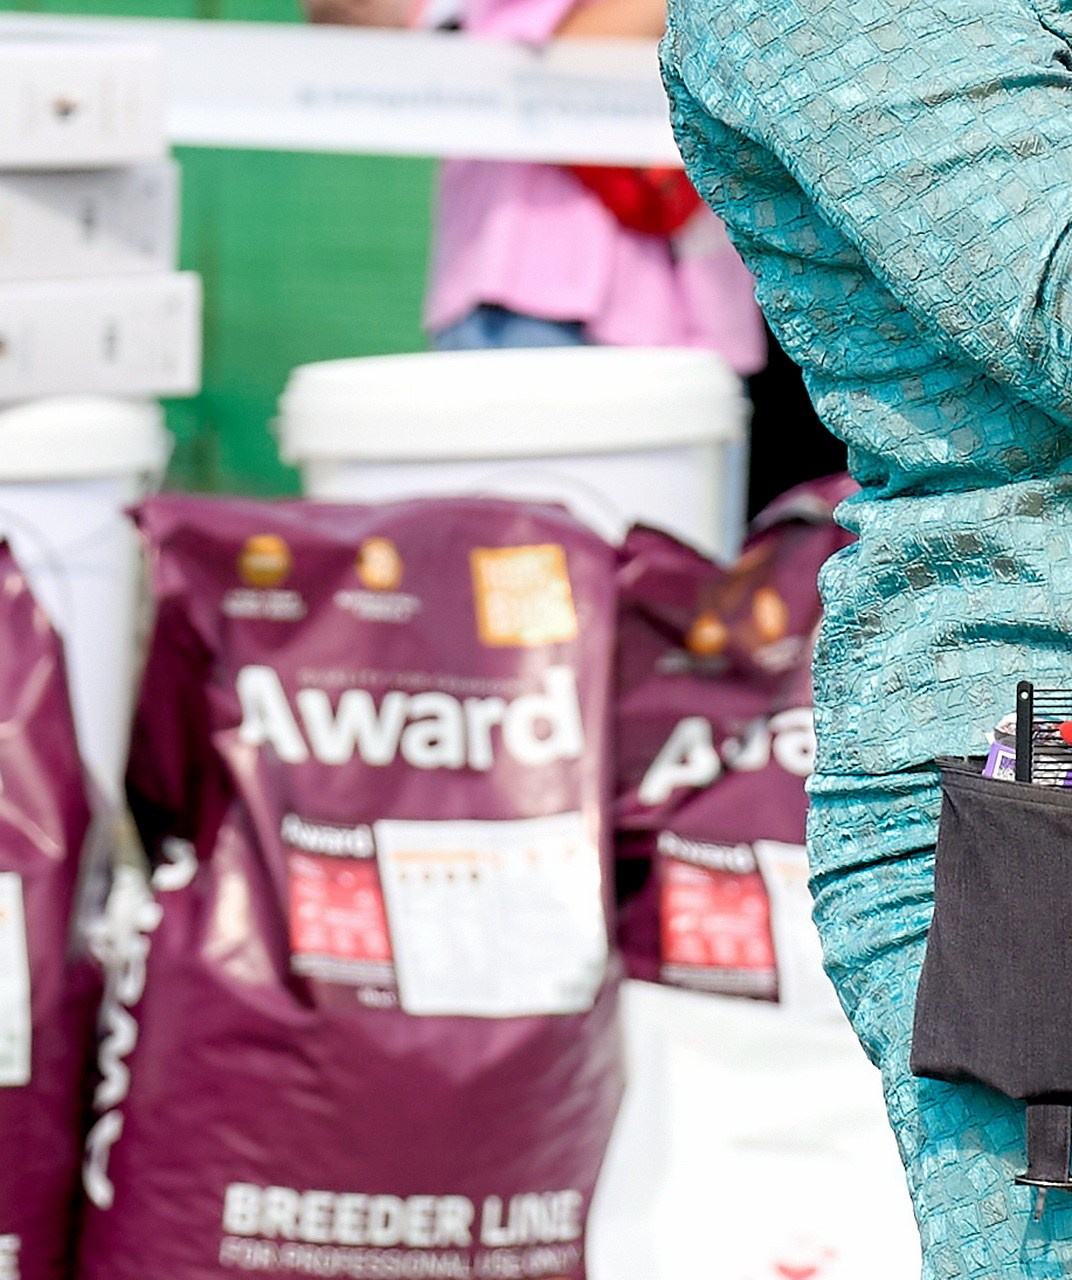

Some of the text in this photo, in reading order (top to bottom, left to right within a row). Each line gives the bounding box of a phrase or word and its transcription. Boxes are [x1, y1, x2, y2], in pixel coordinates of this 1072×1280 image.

[236, 664, 584, 770] Award
[224, 1182, 583, 1249] BREEDER LINE
